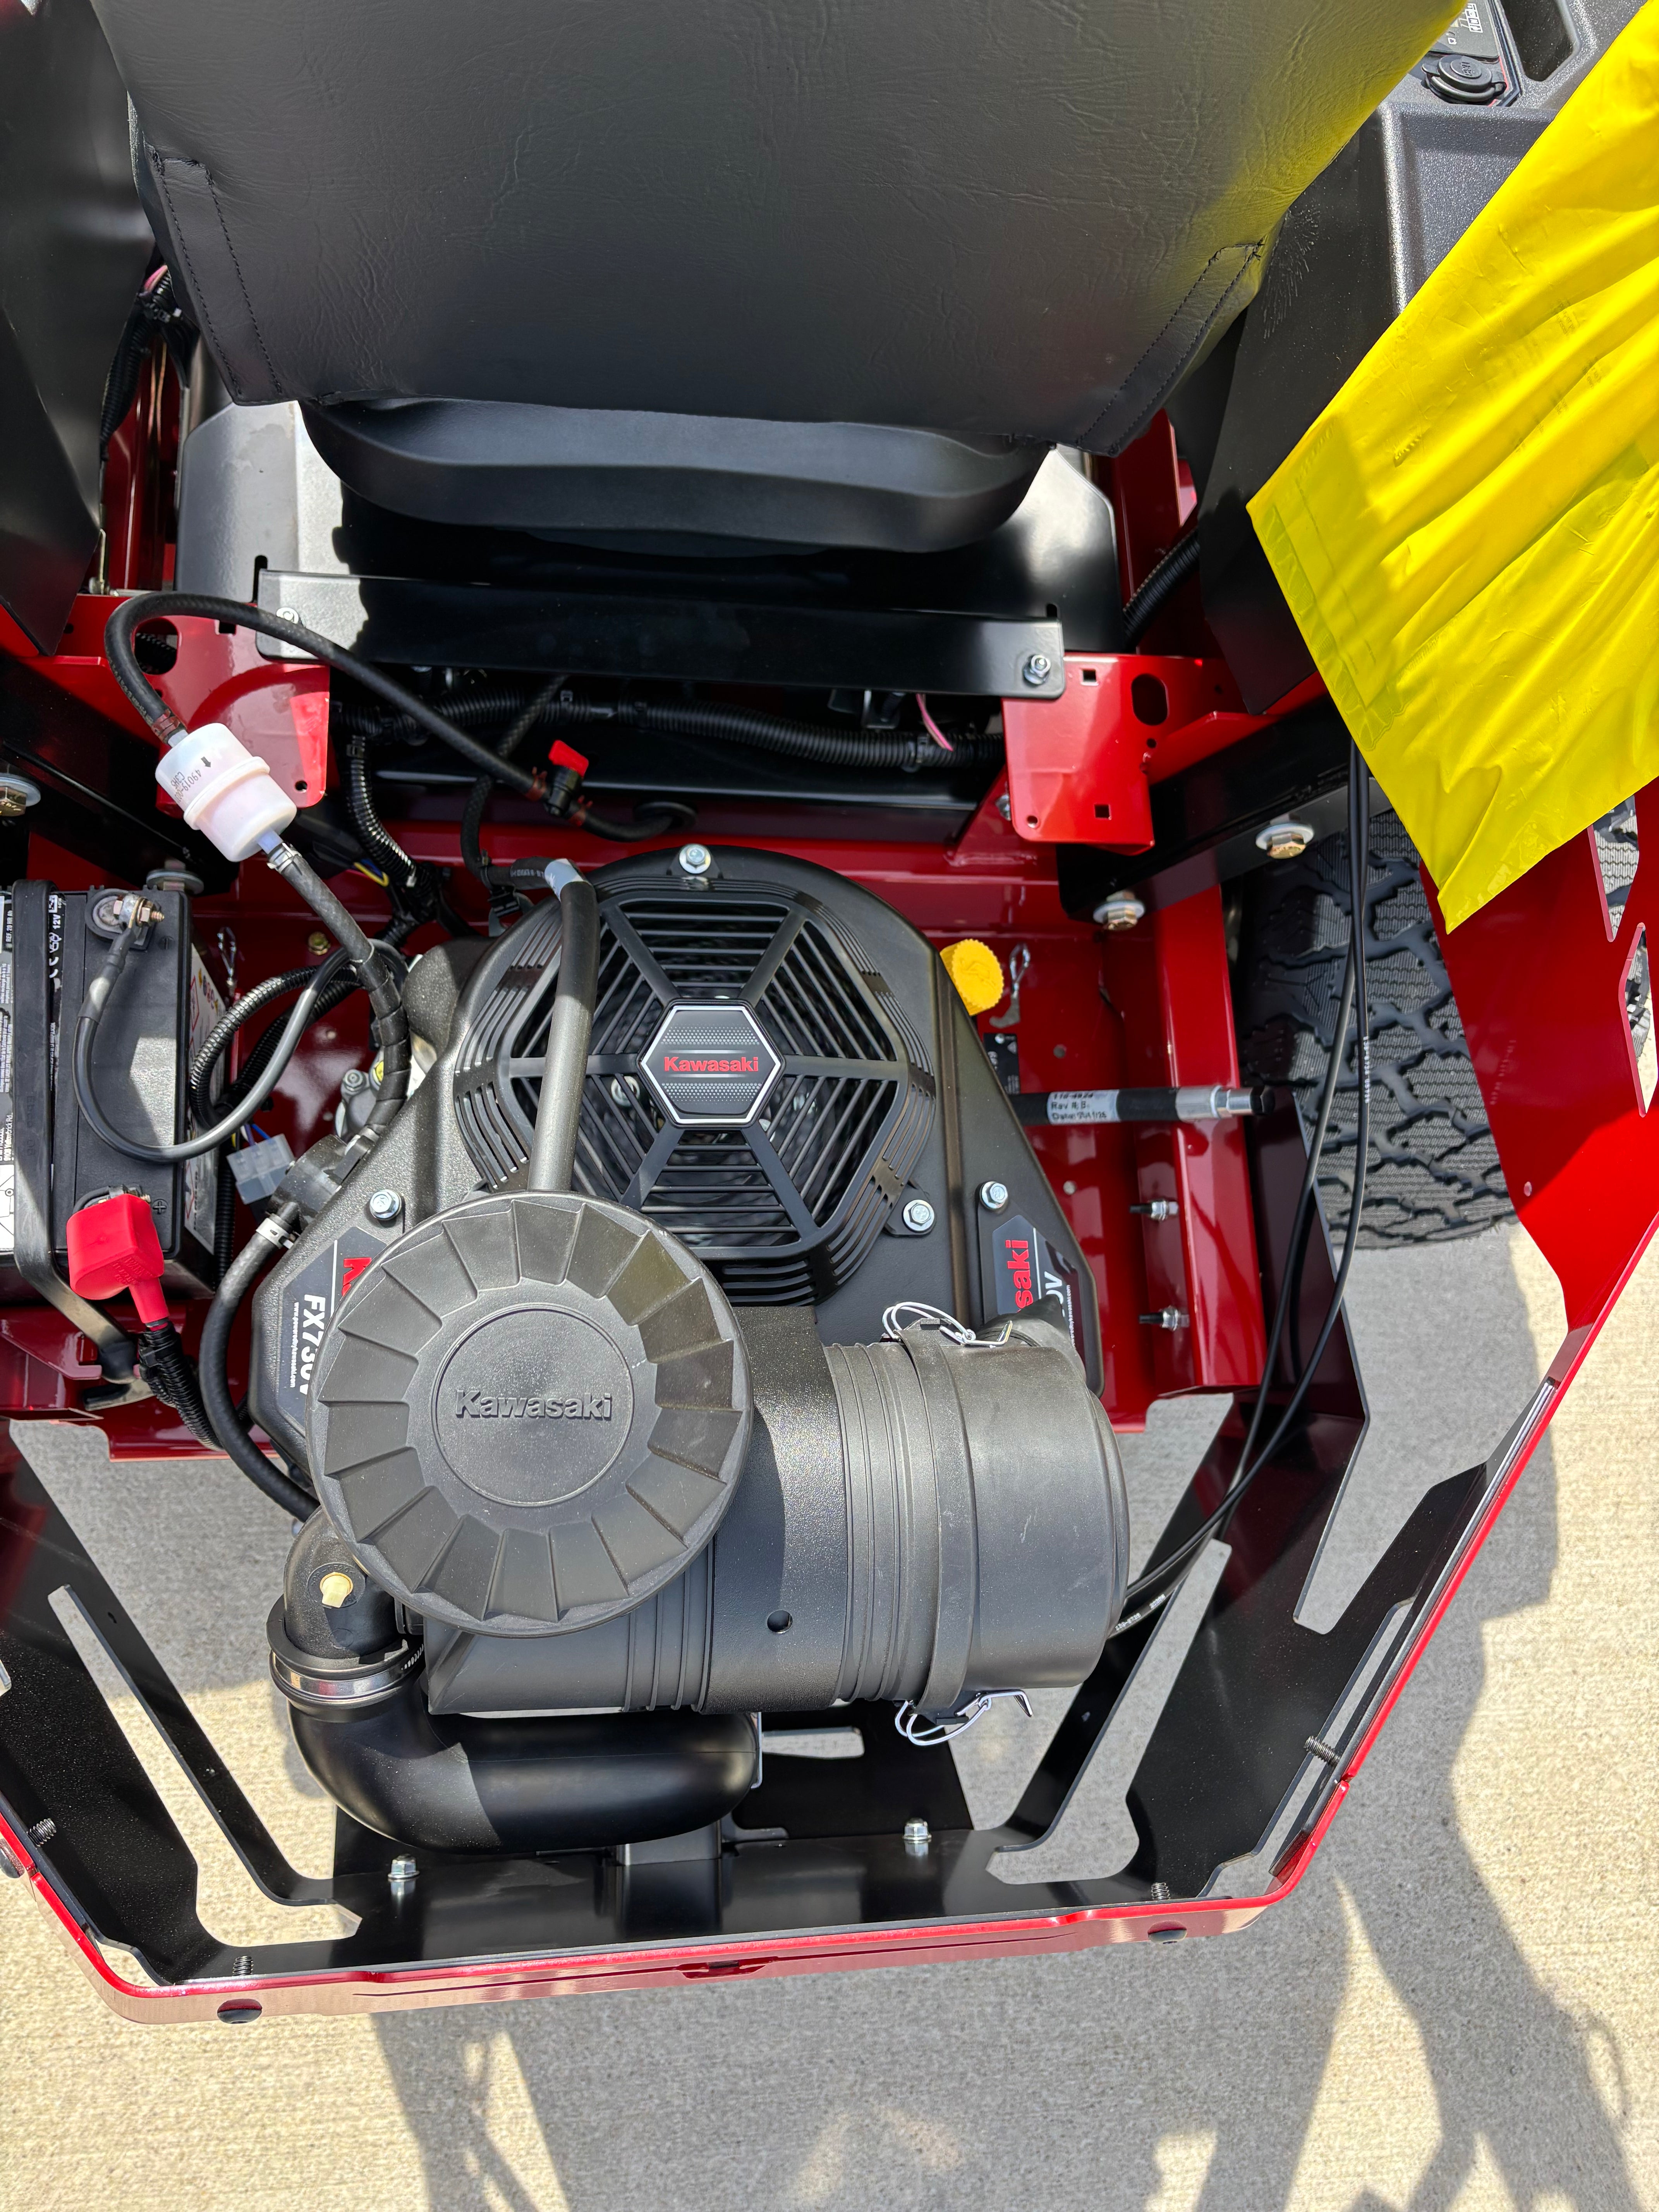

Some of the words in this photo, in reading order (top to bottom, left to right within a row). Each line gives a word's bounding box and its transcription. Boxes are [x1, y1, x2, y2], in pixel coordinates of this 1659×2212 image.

[53, 914, 61, 930] 12V
[664, 1056, 759, 1072] Kawasaki
[1005, 1240, 1034, 1313] saki
[455, 1389, 612, 1421] Kawasaki
